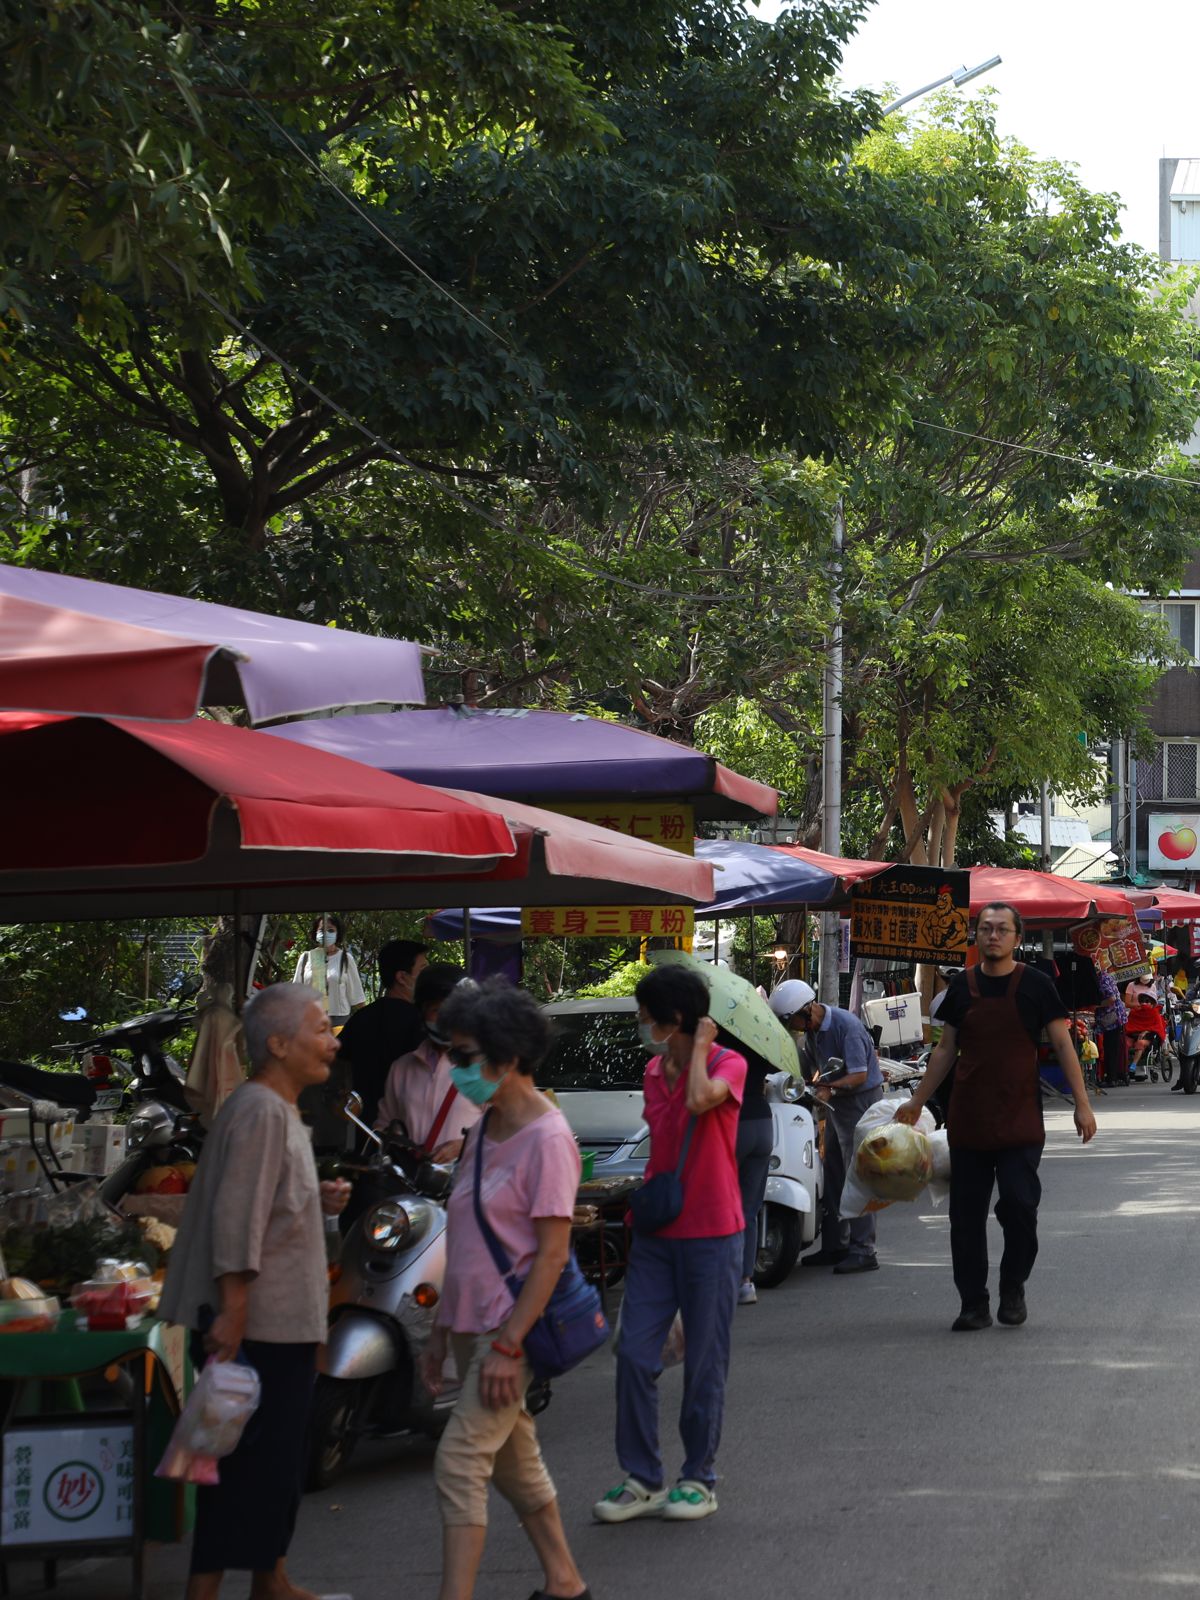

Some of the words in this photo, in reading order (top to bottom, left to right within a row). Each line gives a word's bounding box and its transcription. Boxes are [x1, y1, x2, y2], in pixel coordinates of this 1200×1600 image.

[529, 908, 686, 934] 養身三寶粉
